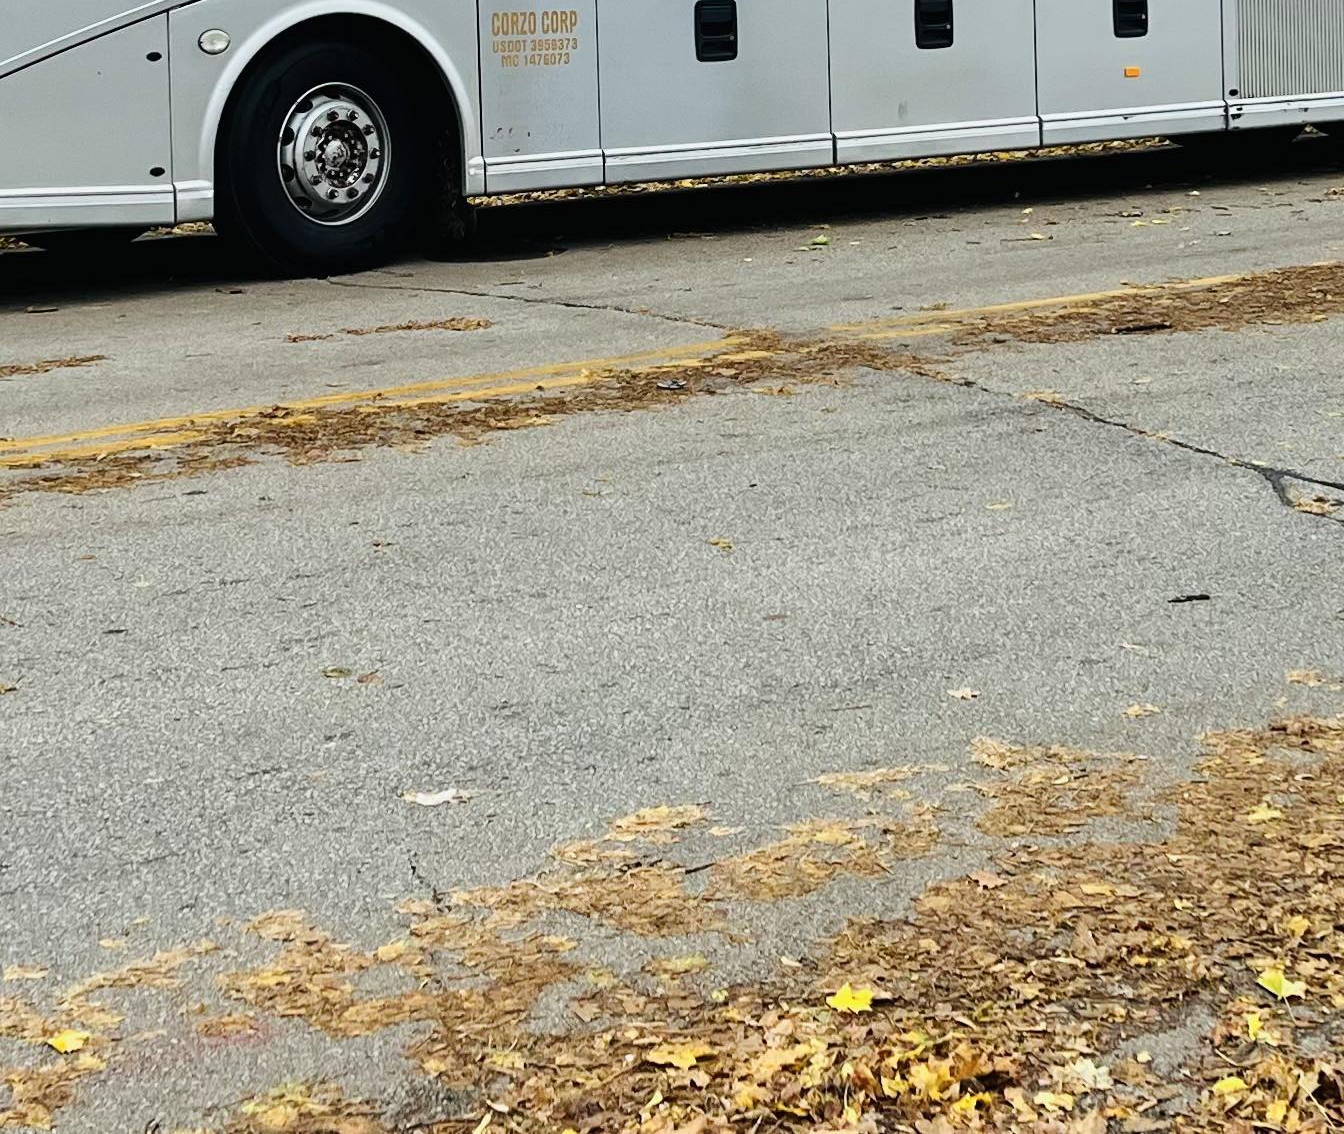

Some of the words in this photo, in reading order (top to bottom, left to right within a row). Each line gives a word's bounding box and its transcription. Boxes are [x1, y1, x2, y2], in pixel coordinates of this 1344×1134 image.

[491, 11, 536, 36] CORZO
[541, 10, 578, 34] CORP
[492, 39, 527, 53] USDOT
[501, 54, 519, 67] MC
[524, 52, 570, 66] 1476073
